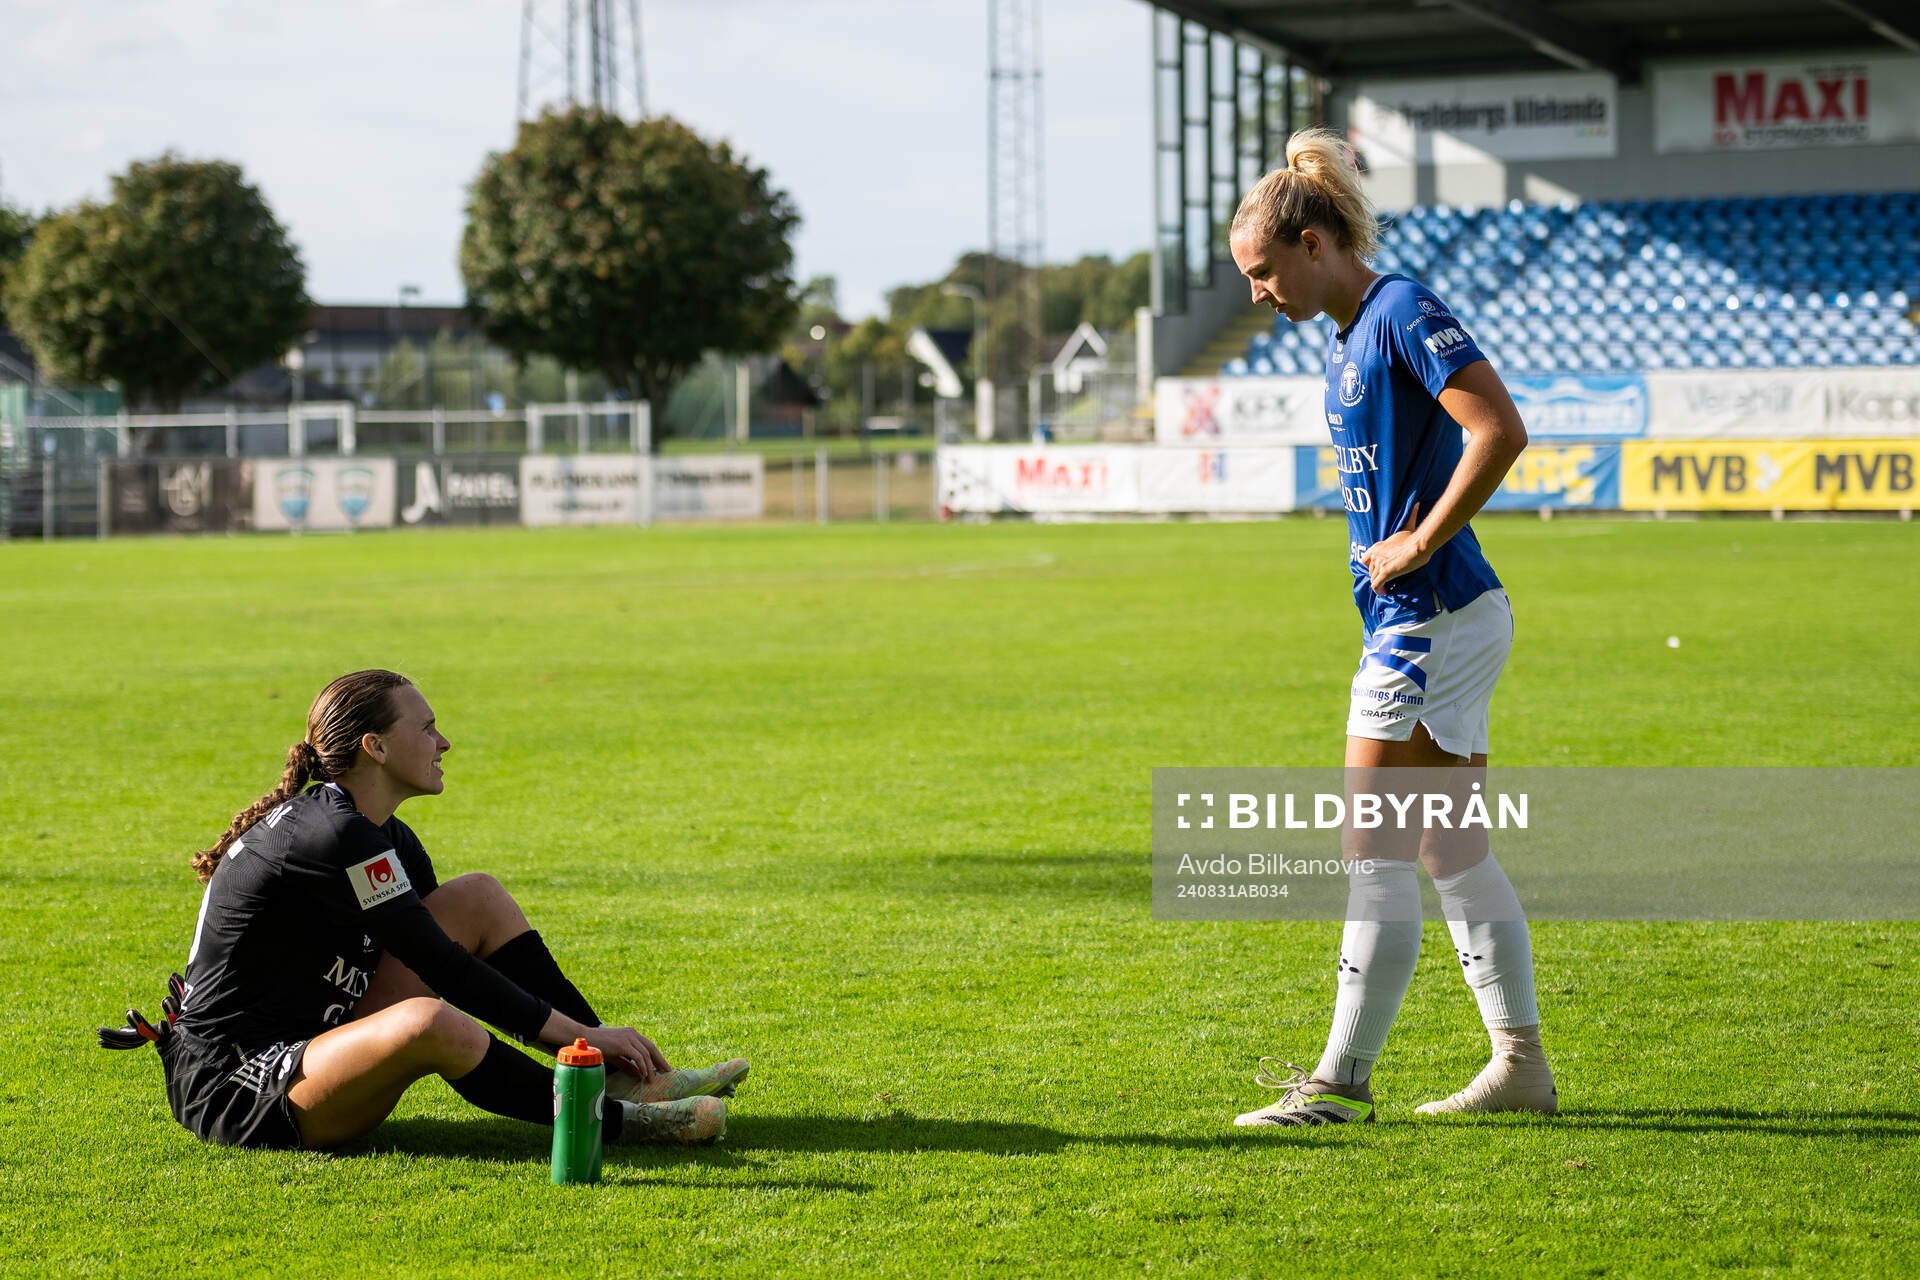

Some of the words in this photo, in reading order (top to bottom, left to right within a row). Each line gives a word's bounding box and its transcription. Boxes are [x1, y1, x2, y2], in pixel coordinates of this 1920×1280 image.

[1714, 73, 1867, 124] MAXI
[1424, 327, 1464, 354] MVB
[1652, 456, 1746, 492] MVB
[1815, 454, 1913, 491] MVB
[1393, 690, 1424, 705] Hamn
[1360, 709, 1395, 719] CRAFT
[362, 886, 397, 906] SVENSKA
